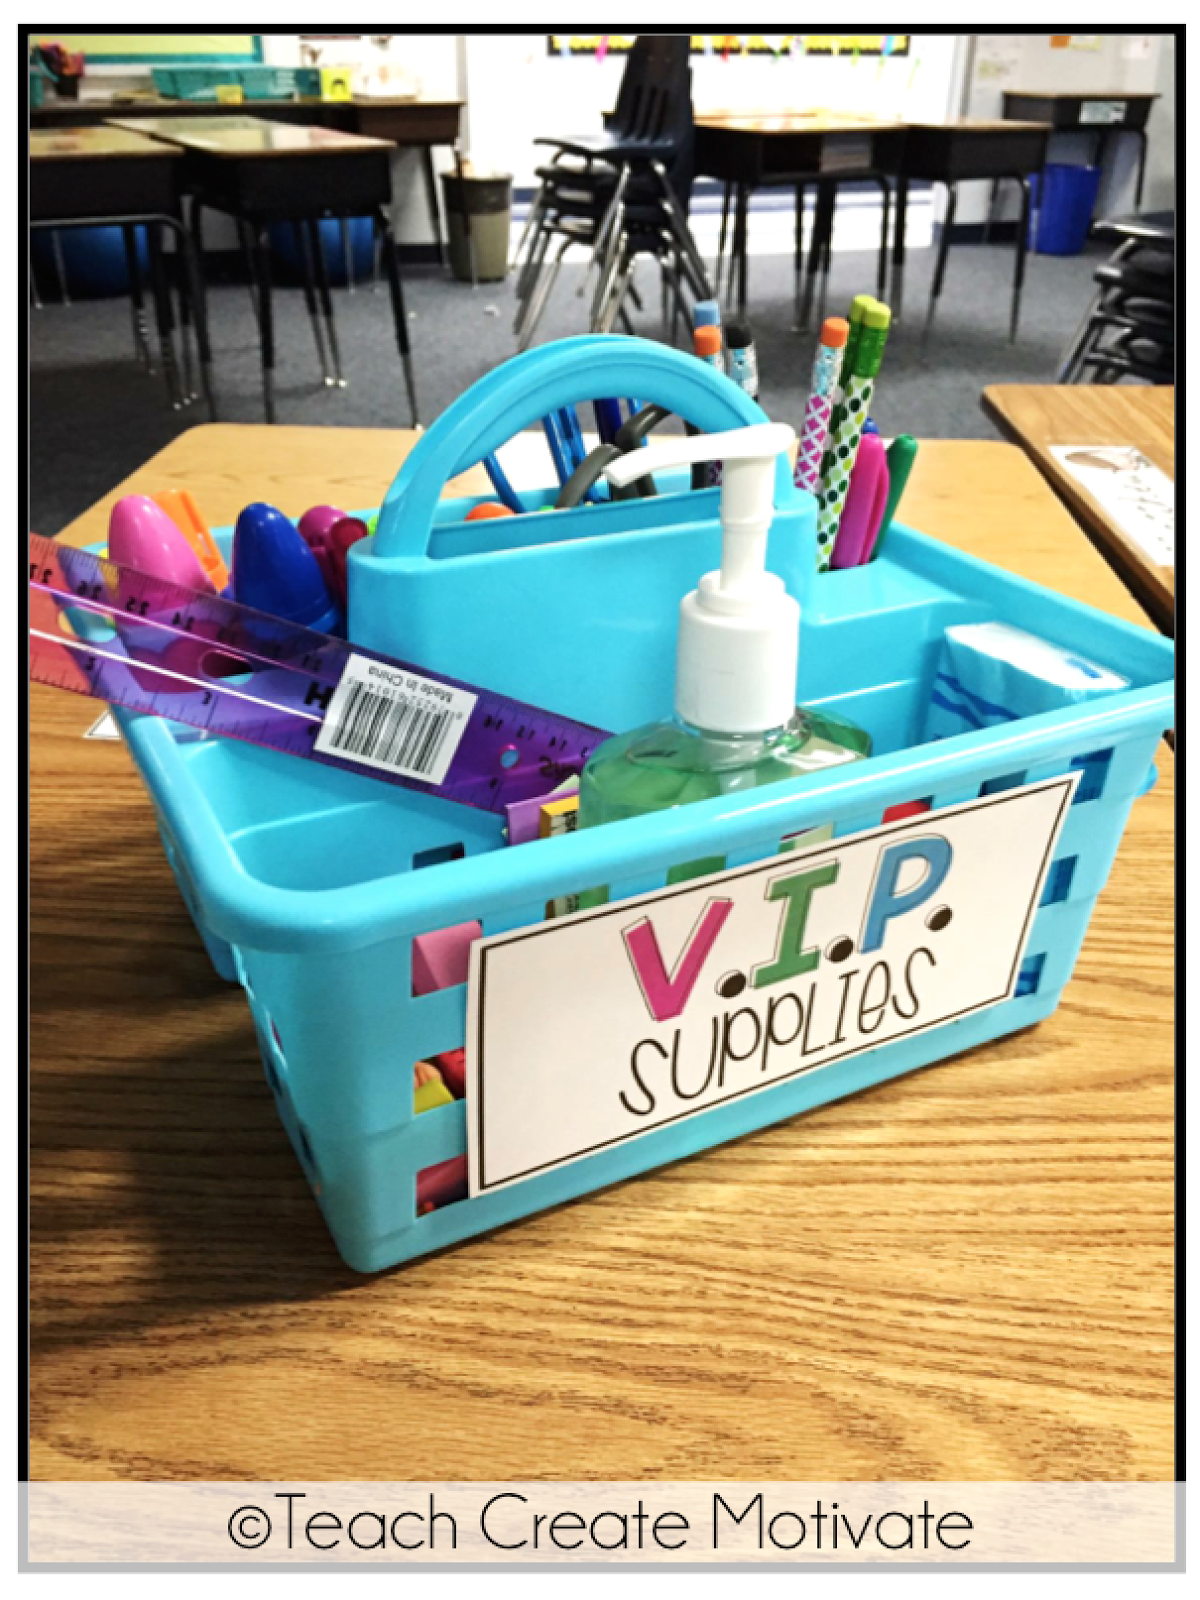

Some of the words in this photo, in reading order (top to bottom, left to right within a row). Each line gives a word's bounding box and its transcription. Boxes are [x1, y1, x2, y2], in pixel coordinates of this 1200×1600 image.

[368, 665, 404, 687] China
[406, 678, 418, 692] in
[420, 684, 453, 704] Made
[621, 832, 954, 1022] V.I.P.
